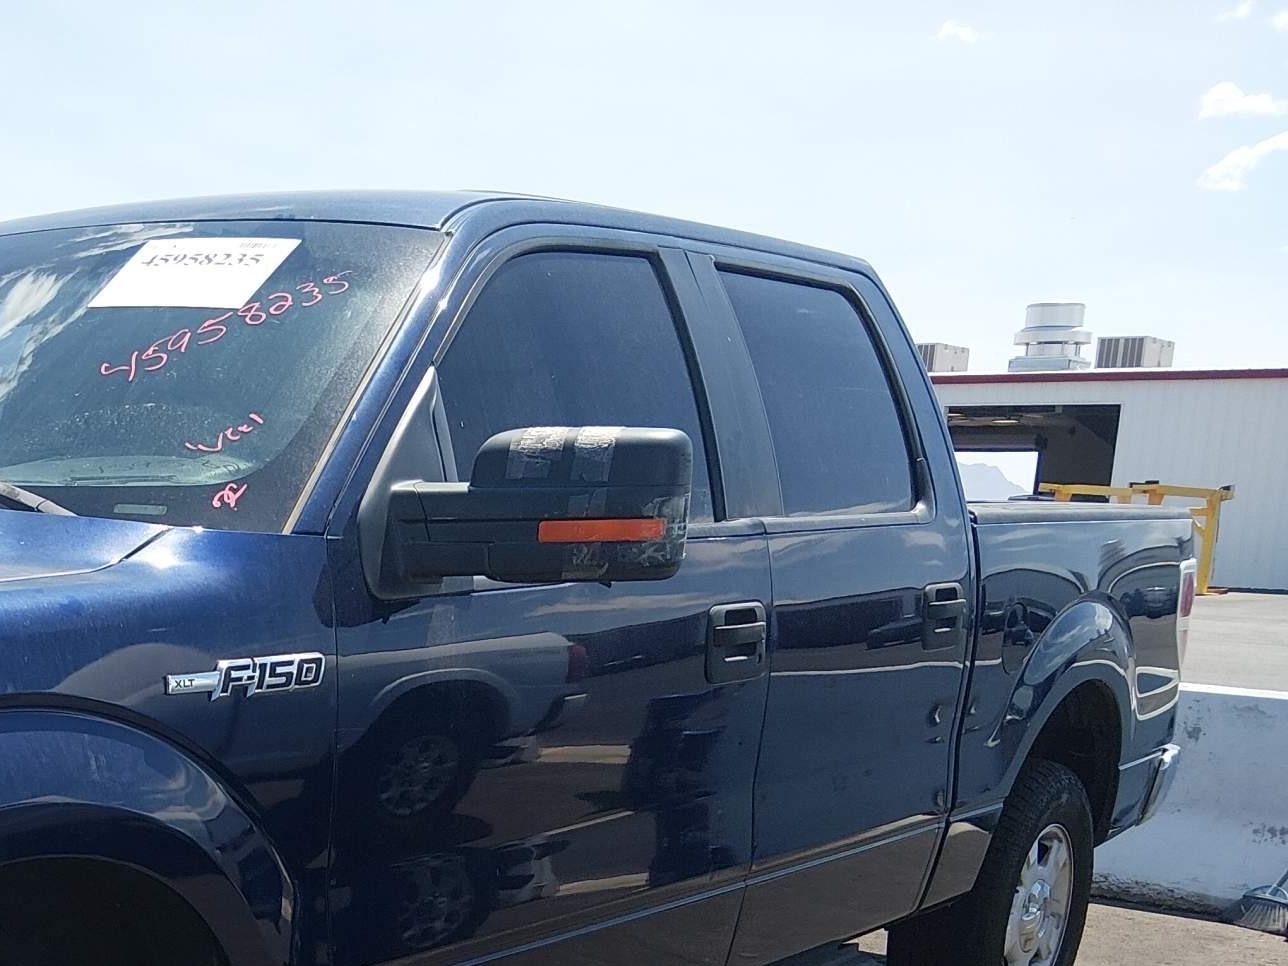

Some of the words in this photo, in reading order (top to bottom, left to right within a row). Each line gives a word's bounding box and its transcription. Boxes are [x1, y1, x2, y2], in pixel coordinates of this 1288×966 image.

[141, 252, 265, 267] 45958235
[100, 271, 351, 381] 45958235
[174, 677, 195, 689] XLT
